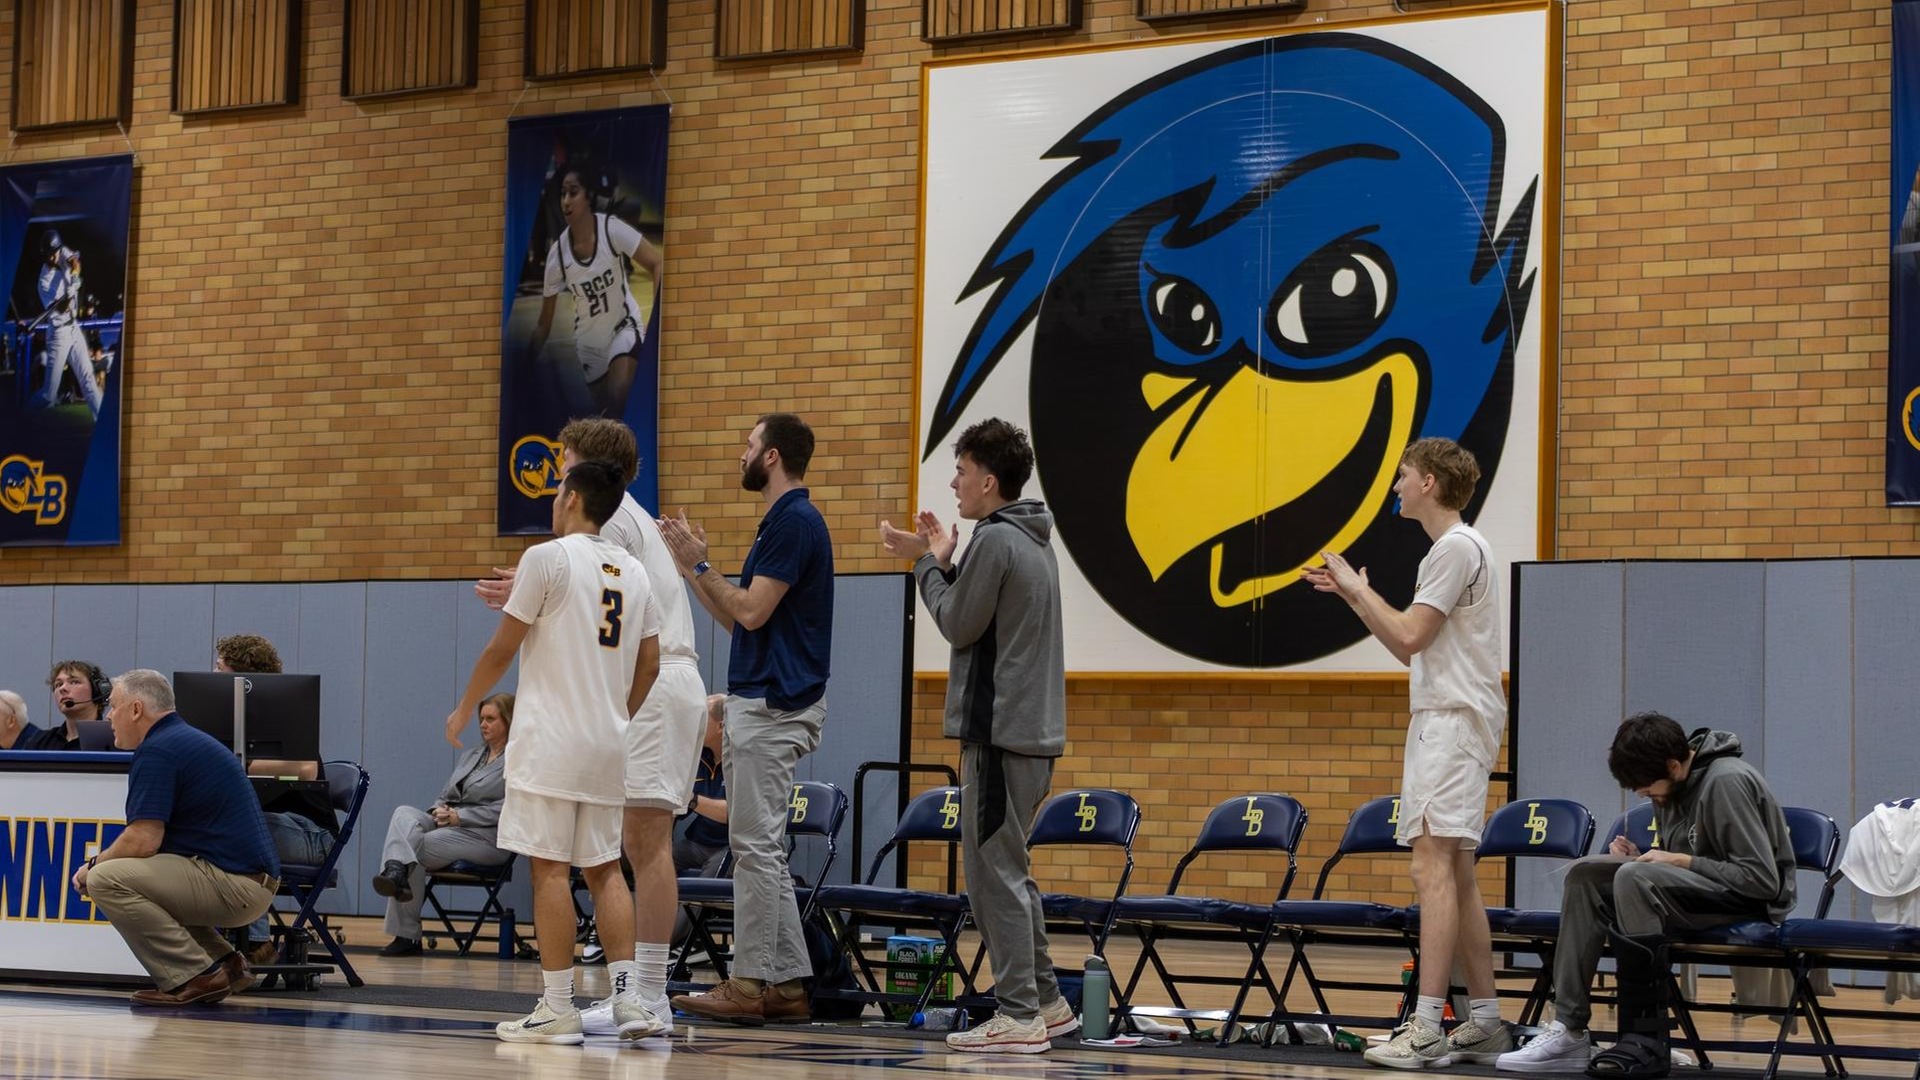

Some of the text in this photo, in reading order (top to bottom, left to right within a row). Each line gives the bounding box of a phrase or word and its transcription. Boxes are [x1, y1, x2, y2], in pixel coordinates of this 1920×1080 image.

[589, 292, 609, 317] 21
[599, 587, 623, 648] 3
[939, 790, 960, 829] LB
[1074, 793, 1097, 832] LB
[1241, 796, 1264, 837] LB
[1523, 802, 1549, 845] LB
[0, 816, 127, 925] NNE
